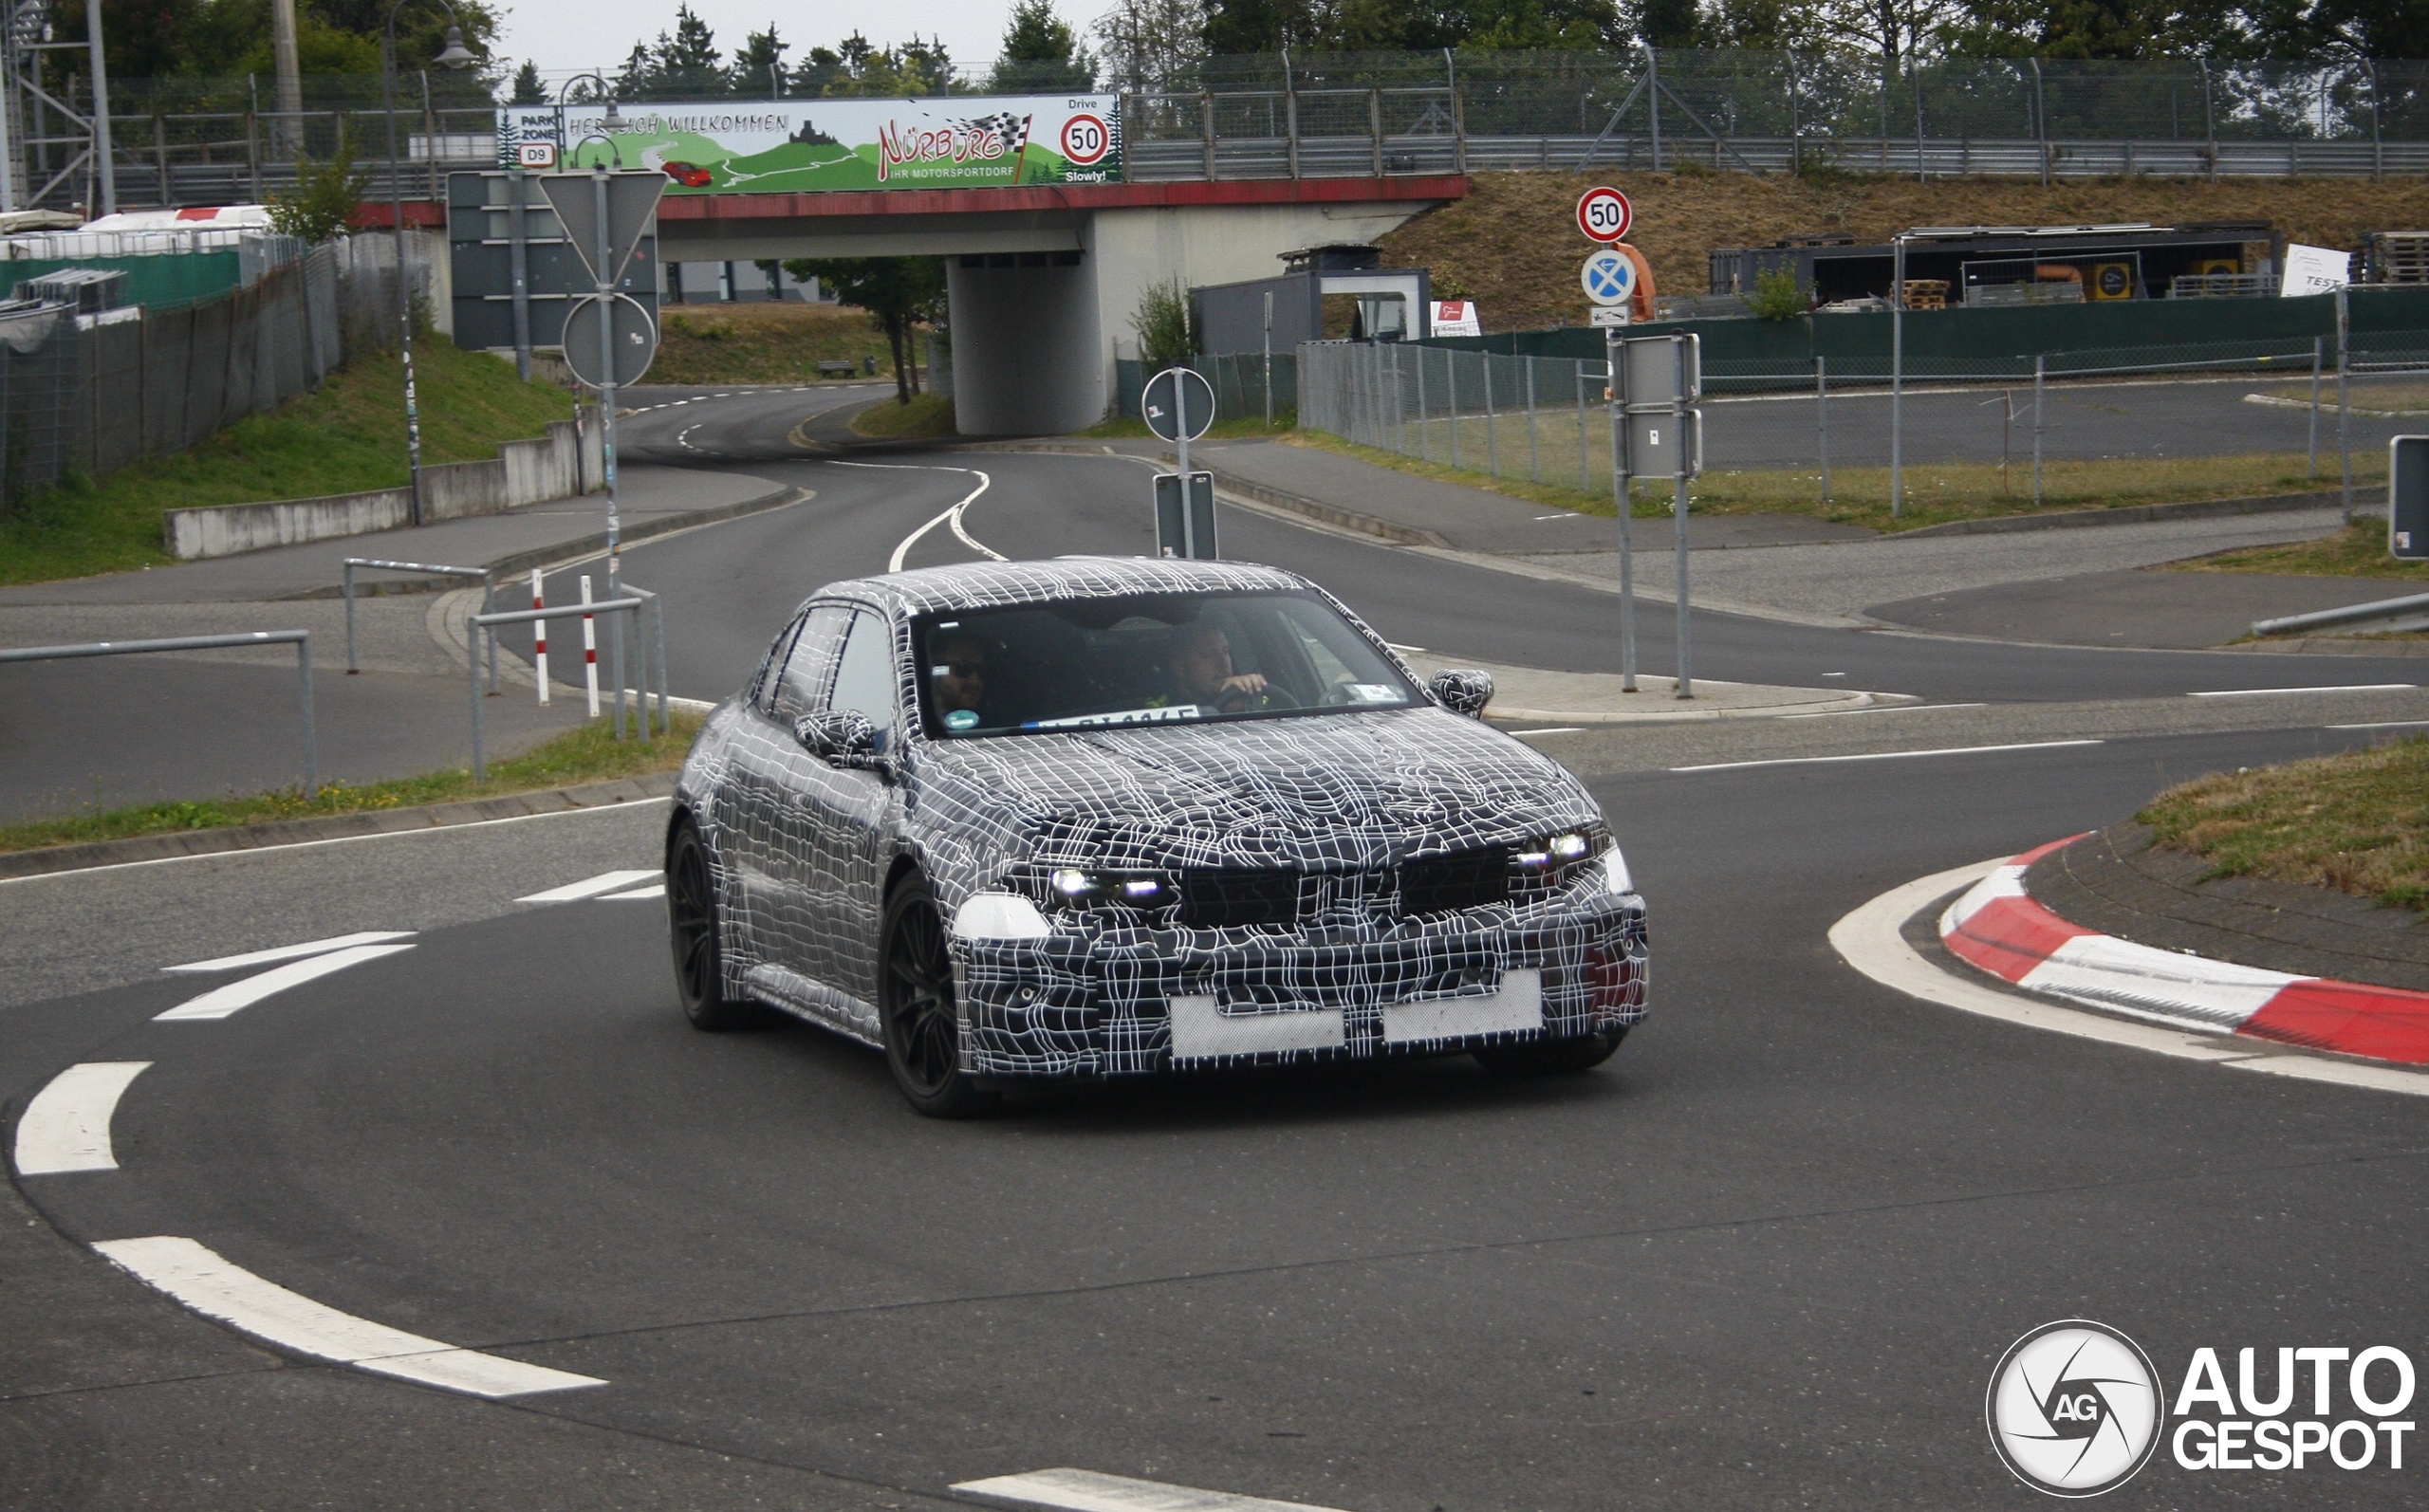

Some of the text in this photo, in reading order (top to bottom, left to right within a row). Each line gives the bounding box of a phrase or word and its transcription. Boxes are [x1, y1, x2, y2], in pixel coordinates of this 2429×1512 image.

[1068, 95, 1097, 109] Drive
[521, 116, 557, 126] PARK
[569, 114, 789, 135] HERICH WILLKOMMEN
[521, 129, 558, 139] ZONE
[1071, 127, 1098, 150] 50
[528, 149, 546, 160] D9
[878, 118, 1005, 182] NÜRBURG
[890, 166, 1014, 178] IHR MOTORSPORTDORF
[1066, 171, 1106, 183] Slowly!
[1590, 202, 1620, 227] 50
